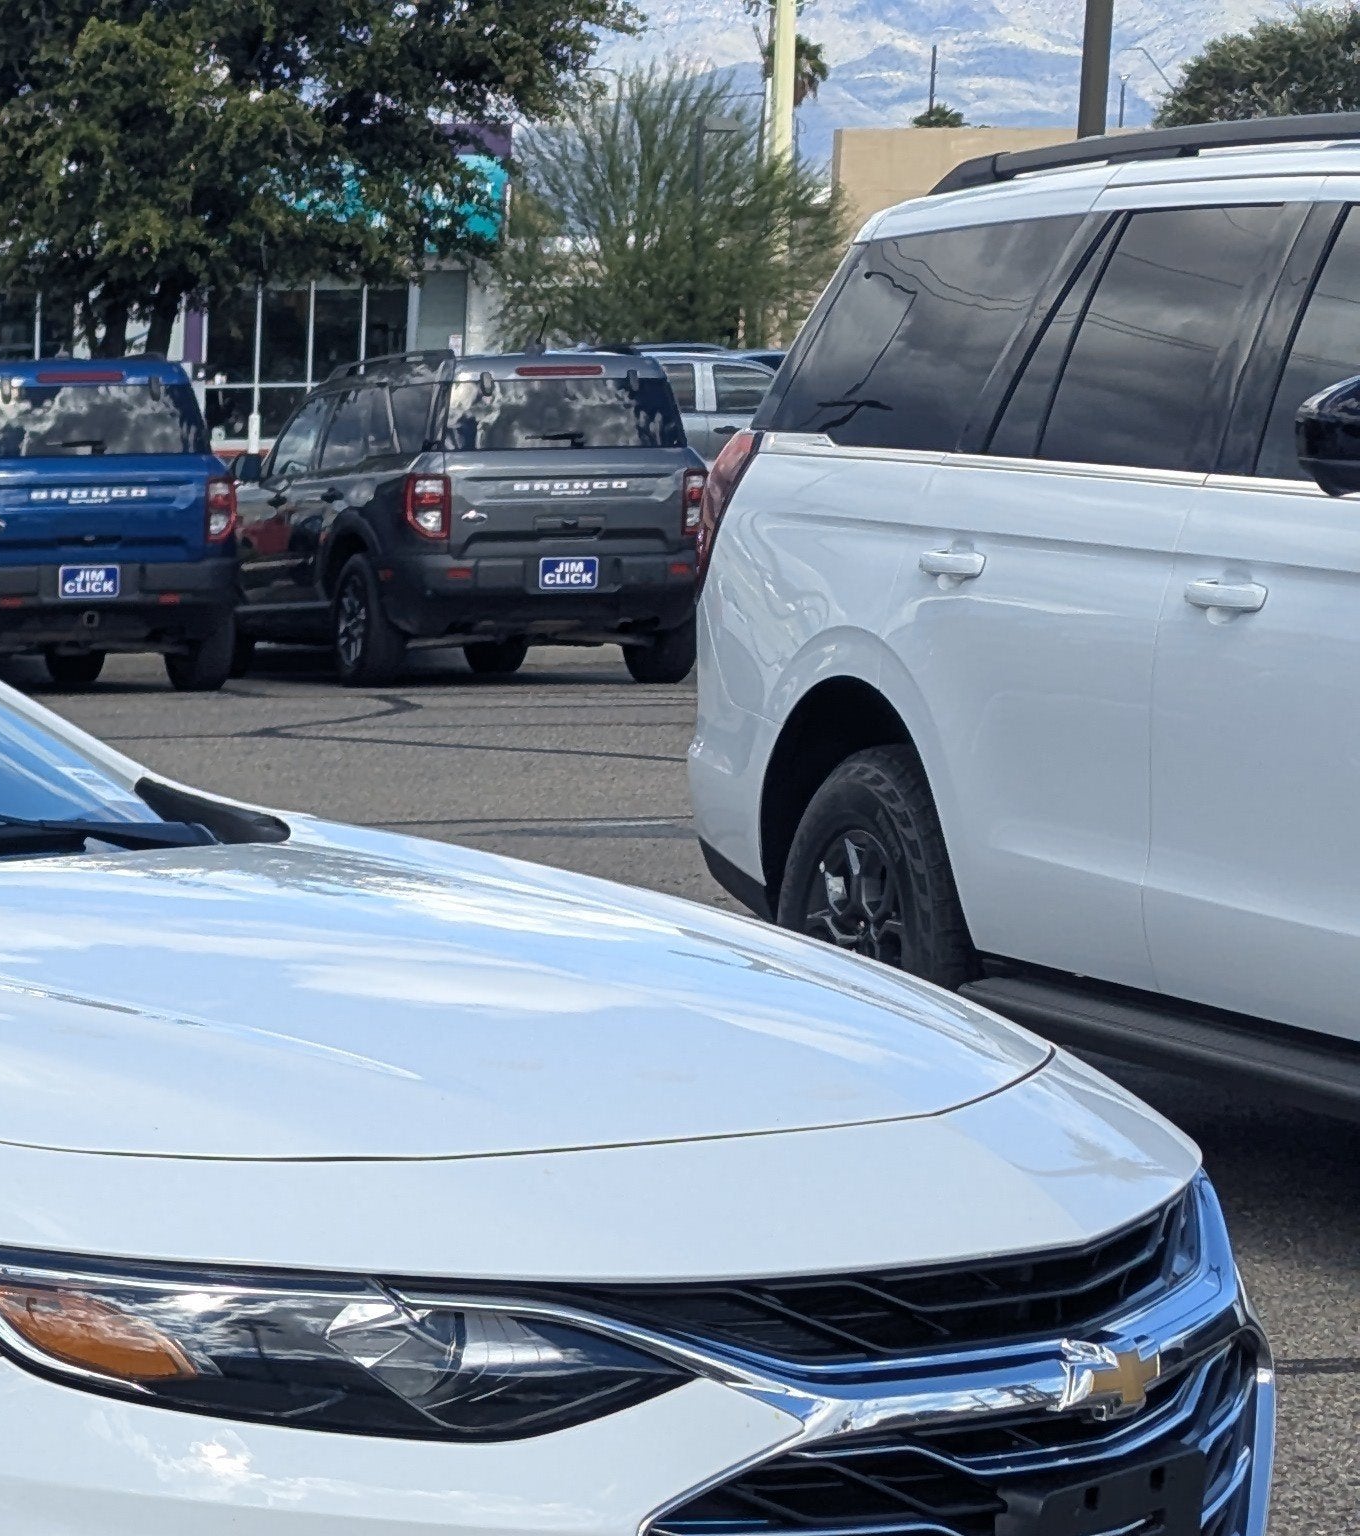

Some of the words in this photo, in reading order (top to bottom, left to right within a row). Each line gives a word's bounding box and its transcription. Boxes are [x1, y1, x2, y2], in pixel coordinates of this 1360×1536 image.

[513, 480, 628, 491] BRONCO
[30, 487, 148, 500] BRONCO
[554, 561, 585, 573] JIM
[74, 569, 106, 582] JIM
[544, 573, 593, 585] CLICK
[64, 581, 114, 594] CLICK
